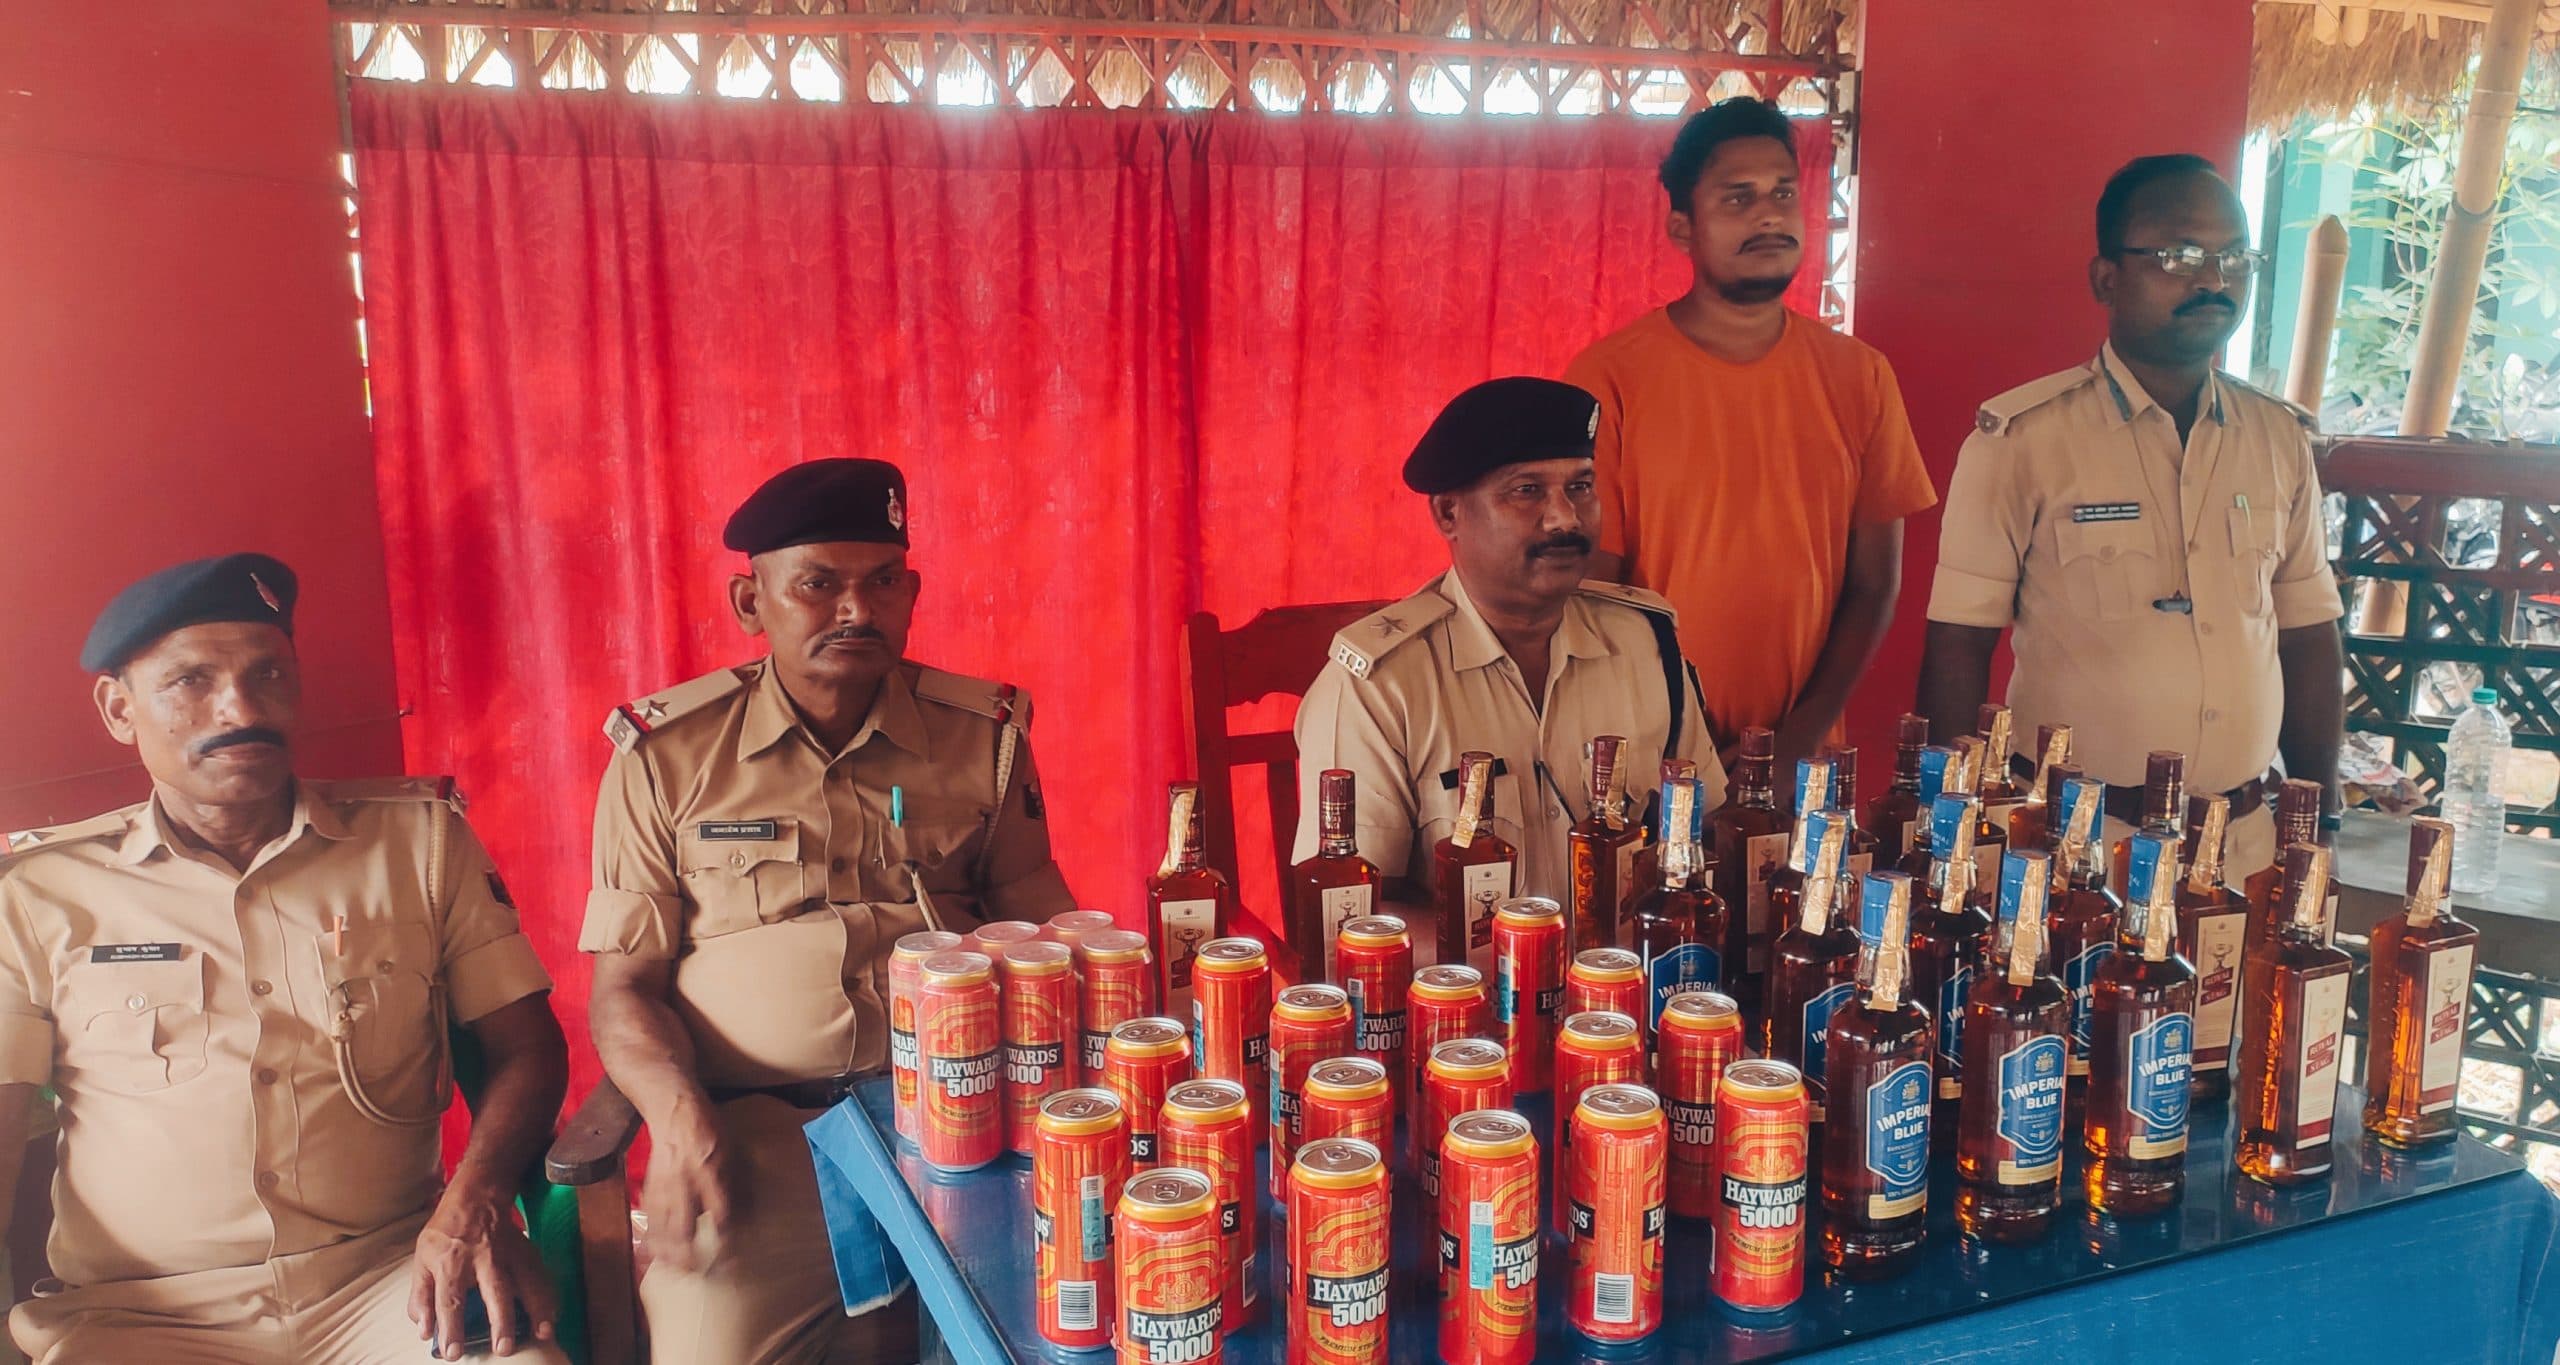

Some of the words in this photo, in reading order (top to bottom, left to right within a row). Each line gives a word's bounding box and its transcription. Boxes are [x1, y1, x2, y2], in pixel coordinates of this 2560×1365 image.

[932, 1053, 999, 1078] HAYWARD
[1008, 1049, 1058, 1065] WARDS
[2138, 1053, 2192, 1077] IMPERIA
[946, 1072, 996, 1098] 5000
[1007, 1064, 1043, 1084] 000
[2155, 1069, 2186, 1086] BLUE
[2009, 1076, 2063, 1101] IMPERIA
[1663, 1099, 1716, 1124] HAYWA
[2026, 1093, 2057, 1110] BLUE
[1876, 1103, 1931, 1132] IMPERIA
[1673, 1123, 1714, 1145] 500
[1894, 1121, 1925, 1141] BLUE
[1725, 1178, 1806, 1206] HAYWARDS
[1740, 1204, 1797, 1229] 5000
[1313, 1268, 1390, 1301] HAYWARD
[1507, 1256, 1539, 1289] 500
[1131, 1302, 1222, 1339] HAYWARDS
[1331, 1291, 1387, 1327] 5000
[1149, 1331, 1213, 1364] 5000
